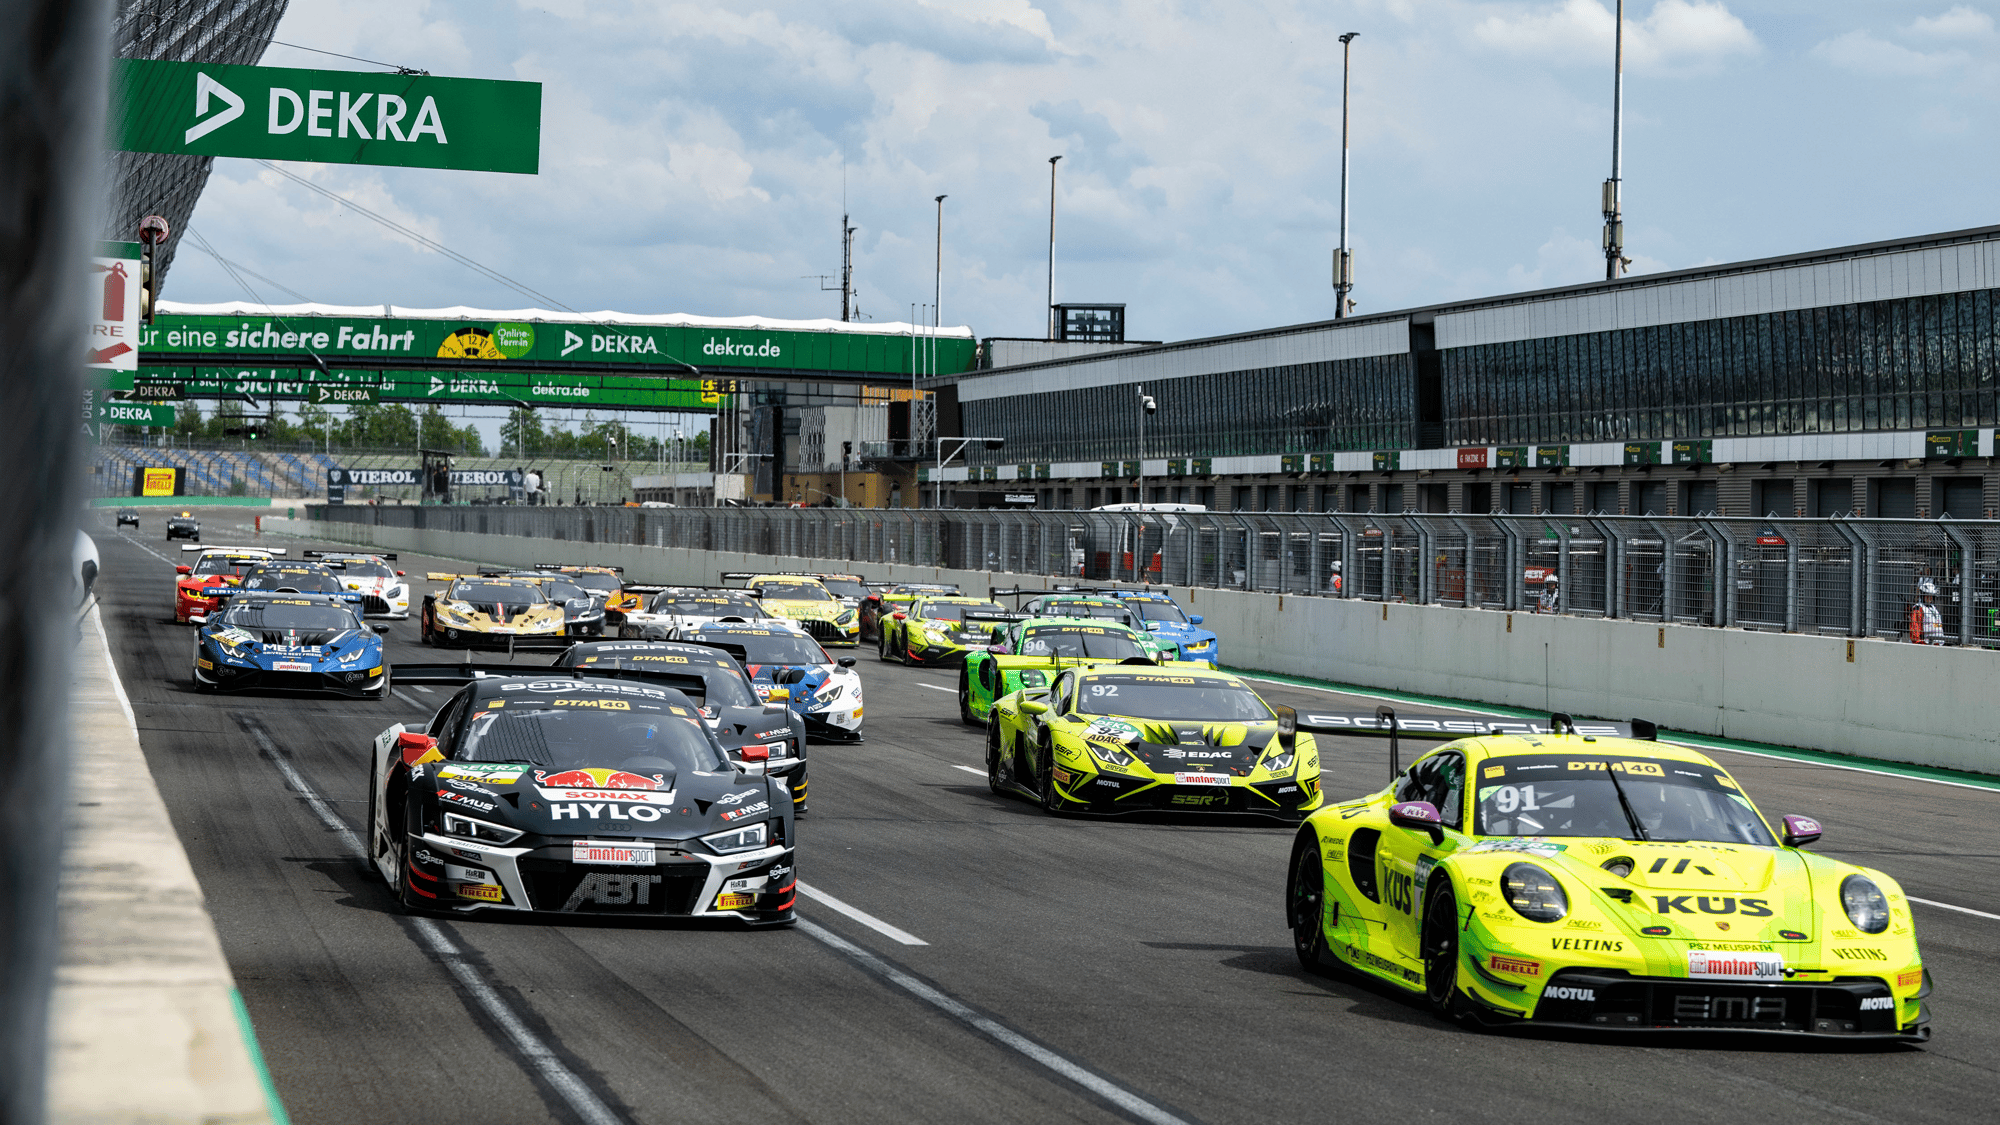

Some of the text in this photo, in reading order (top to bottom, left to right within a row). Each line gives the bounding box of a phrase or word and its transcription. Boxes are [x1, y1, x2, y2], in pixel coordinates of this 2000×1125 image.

[267, 87, 449, 144] DEKRA
[137, 323, 415, 352] ür eine sichere Fahrt
[591, 333, 658, 354] DEKRA
[703, 337, 781, 358] dekra.de
[140, 386, 176, 397] DEKRA
[449, 379, 499, 395] DEKRA
[531, 382, 590, 397] dekra.de
[334, 390, 370, 401] DEKRA
[110, 407, 152, 421] DEKRA
[348, 470, 416, 484] VIEROL
[234, 605, 250, 613] 71
[263, 643, 322, 653] MEYLE
[1025, 640, 1045, 653] 90
[500, 681, 667, 698] SCHERER
[1091, 685, 1119, 697] 92
[601, 701, 628, 710] 40
[1307, 714, 1620, 736] PORSCHE
[1567, 762, 1659, 775] DTM 40
[1096, 779, 1121, 789] MOTUL
[1186, 775, 1231, 786] motorsport
[565, 791, 649, 801] SONAX
[1278, 785, 1298, 794] MOTUL
[440, 791, 494, 811] REMUS
[1497, 785, 1540, 814] 91
[550, 802, 662, 822] HYLO
[727, 800, 769, 819] REMUS
[448, 840, 490, 851] SCHAEFFLER
[415, 850, 444, 866] SCHERER
[589, 846, 655, 864] motorsport
[457, 883, 498, 899] PIRELLI
[720, 894, 754, 907] PIRELLI
[1651, 895, 1774, 917] KÜS
[1551, 938, 1623, 952] VELTINS
[1688, 943, 1773, 953] PSZ MEUSPATH
[1831, 948, 1888, 961] VELTINS
[1491, 956, 1540, 976] PIRELLI
[1708, 959, 1783, 978] motorsport
[1544, 986, 1596, 1001] MOTUL
[1860, 997, 1895, 1010] MOTUL
